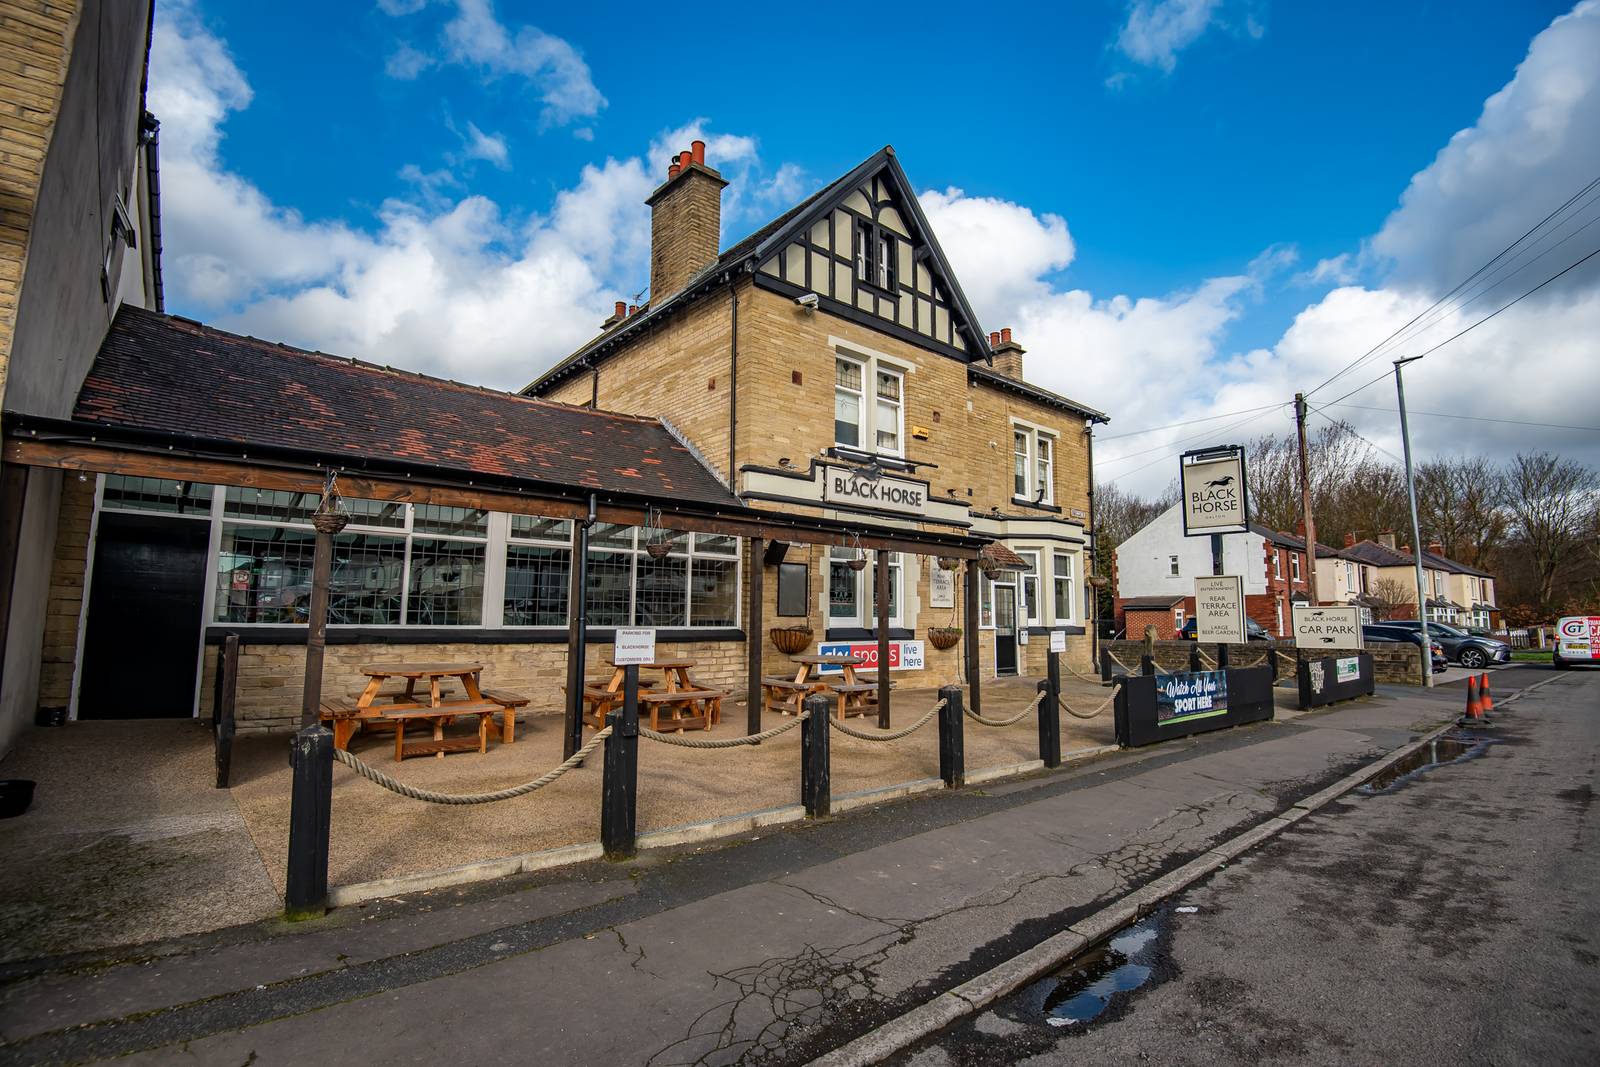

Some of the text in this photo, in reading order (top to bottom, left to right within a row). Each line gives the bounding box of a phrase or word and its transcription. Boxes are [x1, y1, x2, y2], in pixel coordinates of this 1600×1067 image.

[835, 477, 922, 507] BLACK HORSE
[1192, 488, 1236, 502] BLACK
[1192, 500, 1238, 514] HORSE
[1201, 602, 1237, 610] TERRACE
[1299, 625, 1356, 634] CAR PARK
[1568, 625, 1584, 633] GT
[903, 644, 917, 655] live
[853, 649, 897, 667] spos
[903, 656, 922, 667] here
[1166, 677, 1189, 698] Watch
[1190, 677, 1203, 696] All
[1174, 695, 1213, 713] SPORT HERE
